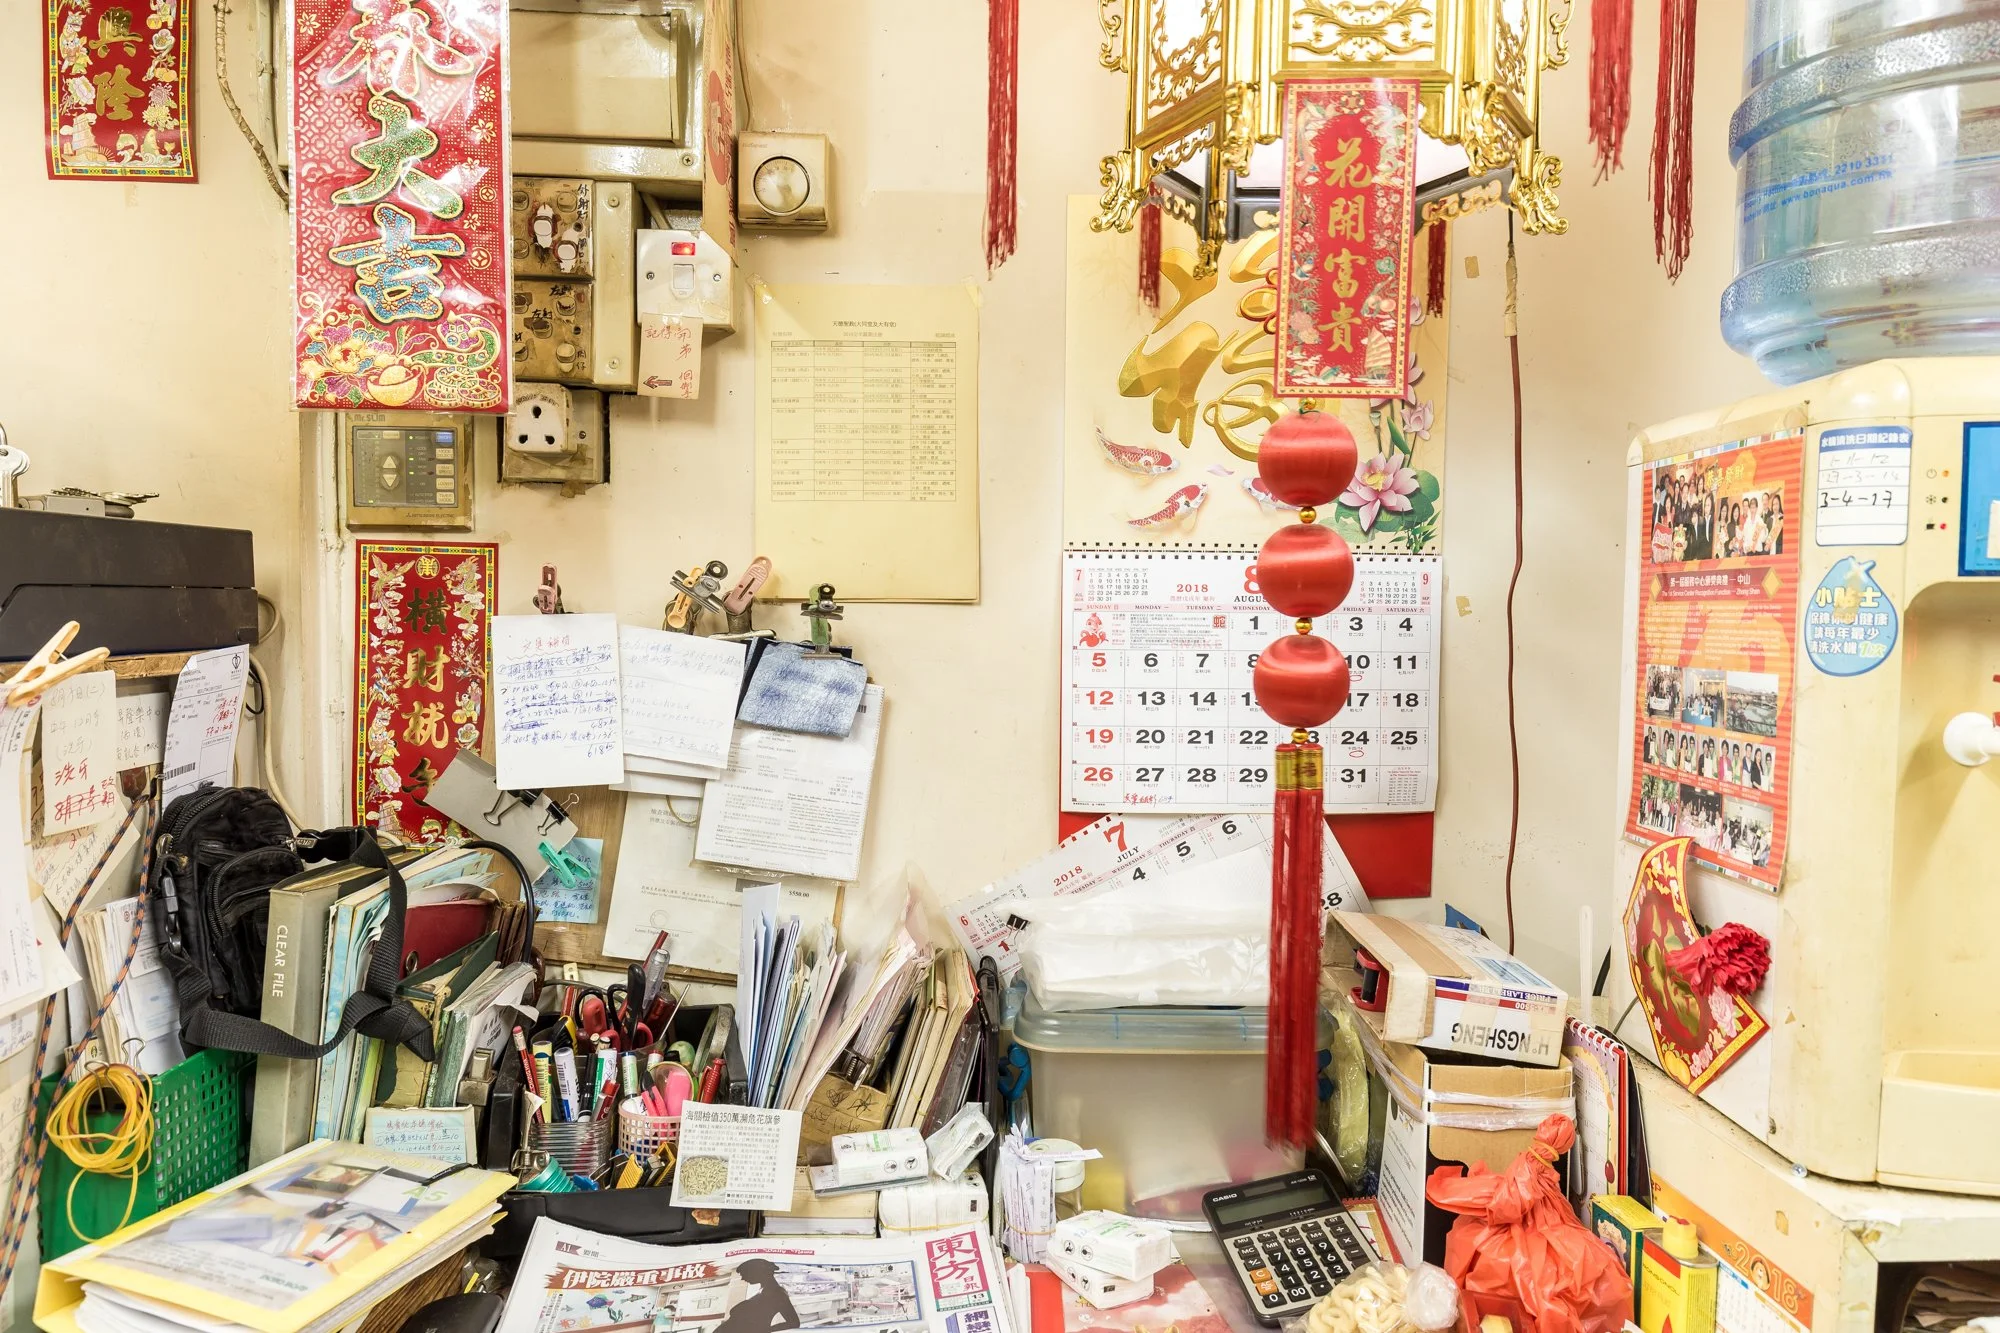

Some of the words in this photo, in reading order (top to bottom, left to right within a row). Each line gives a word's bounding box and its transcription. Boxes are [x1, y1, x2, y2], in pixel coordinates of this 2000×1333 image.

[88, 10, 144, 122] 興隆
[1318, 137, 1373, 354] 花開富貴
[1820, 490, 1893, 509] 3-4-17
[1077, 570, 1081, 581] 7
[1423, 574, 1428, 585] 9
[1177, 584, 1208, 592] 2018
[1250, 616, 1258, 630] 1
[1350, 617, 1363, 631] 3
[1399, 618, 1412, 631] 4
[1092, 653, 1106, 667] 5
[1144, 653, 1158, 667] 6
[1196, 654, 1209, 667] 7
[1345, 655, 1371, 669] 10
[1394, 655, 1416, 669] 11
[1086, 691, 1113, 705] 12
[1138, 691, 1165, 705] 13
[1190, 692, 1217, 705] 14
[1347, 693, 1370, 707] 17
[1393, 693, 1418, 707] 18
[1086, 729, 1113, 743] 19
[1136, 730, 1165, 743] 20
[1188, 730, 1213, 744] 21
[1240, 730, 1268, 744] 22
[1341, 731, 1369, 744] 24
[1391, 731, 1417, 745] 25
[54, 757, 89, 787] 洗牙
[1084, 767, 1113, 781] 26
[1136, 768, 1164, 781] 27
[1188, 768, 1216, 782] 28
[1239, 768, 1268, 782] 29
[1341, 769, 1365, 782] 31
[1103, 821, 1128, 852] 7
[1117, 845, 1141, 863] JULY
[1158, 830, 1190, 849] THURSDAY
[1132, 866, 1147, 883] 4
[1176, 841, 1191, 858] 5
[1221, 820, 1238, 835] 6
[1111, 854, 1147, 875] WEDNESDAY
[1053, 865, 1084, 887] 2018
[960, 915, 969, 926] 6
[274, 925, 289, 967] CLEAR
[985, 929, 1008, 944] SUNDAY
[272, 972, 285, 998] FILE
[1525, 991, 1552, 1003] PRICE
[402, 1185, 448, 1202] A5
[1212, 1193, 1238, 1203] CASIO
[928, 1238, 981, 1283] 東方
[1274, 1252, 1282, 1261] 7
[1296, 1247, 1306, 1256] 8
[1318, 1242, 1328, 1250] 9
[1281, 1264, 1291, 1272] 4
[1303, 1258, 1313, 1267] 5
[1327, 1253, 1336, 1262] 6
[562, 1262, 707, 1289] 伊院嚴重事故
[1256, 1270, 1266, 1278] C
[1288, 1276, 1295, 1284] 1
[1310, 1270, 1321, 1279] 2
[1333, 1265, 1343, 1274] 3
[1269, 1293, 1278, 1302] 0
[1291, 1287, 1306, 1296] 00
